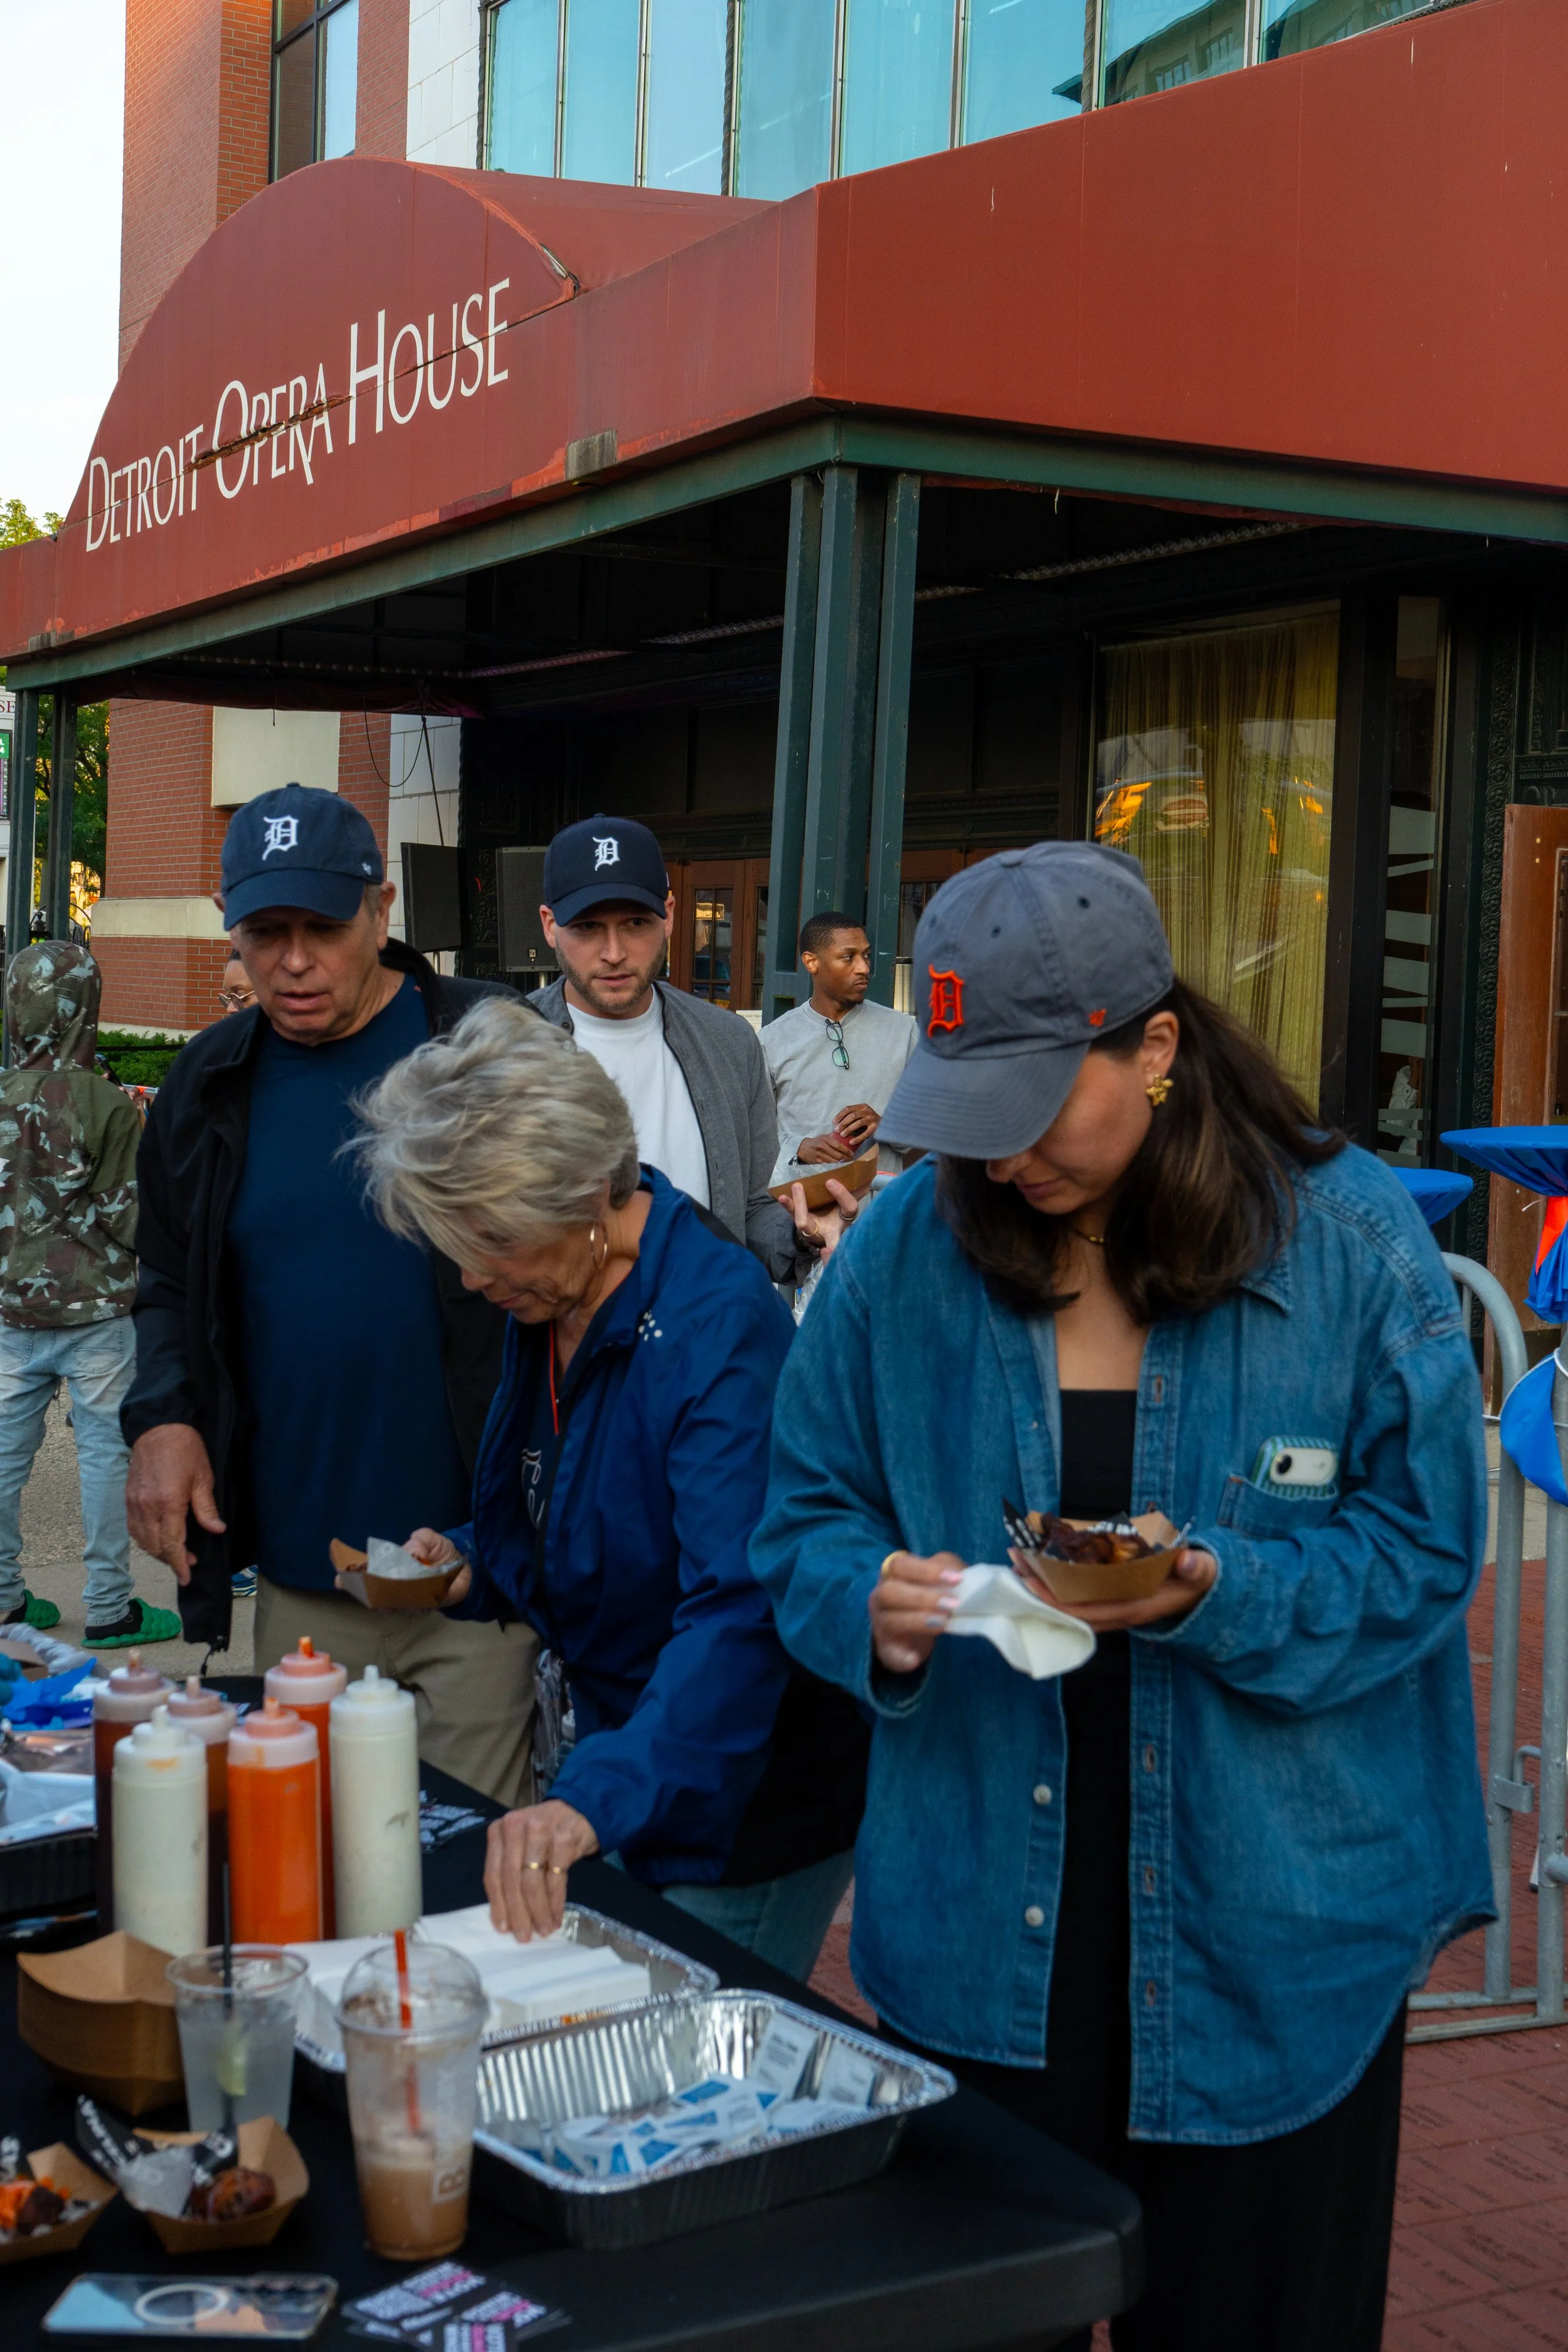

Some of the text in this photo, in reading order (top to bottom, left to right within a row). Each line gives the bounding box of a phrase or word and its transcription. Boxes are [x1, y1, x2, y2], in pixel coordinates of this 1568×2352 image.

[85, 277, 510, 553] DETROIT OPERA HOUSE
[262, 815, 299, 861] D
[592, 837, 620, 871] D
[927, 964, 965, 1038] D
